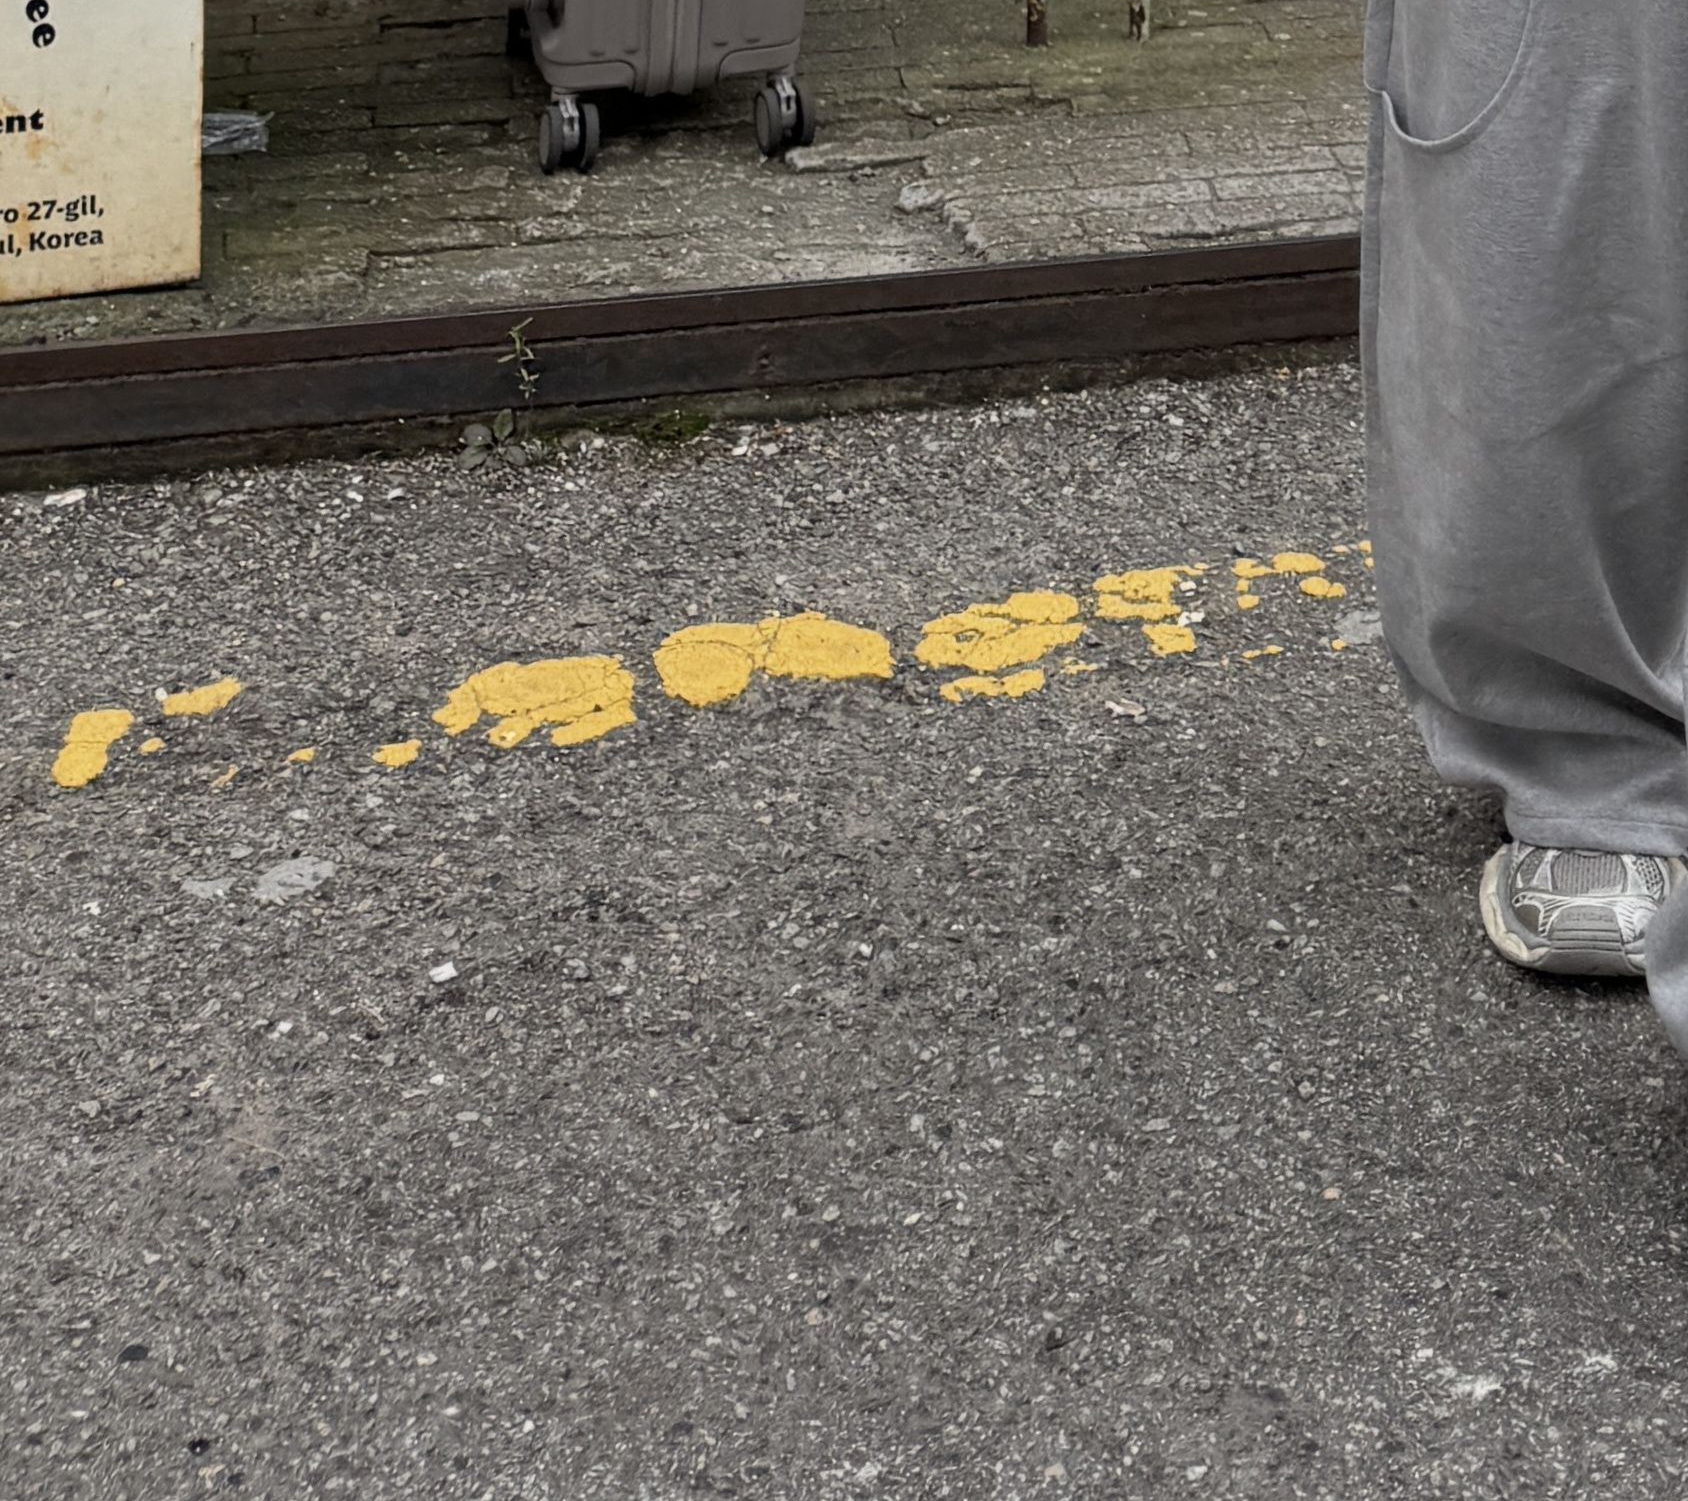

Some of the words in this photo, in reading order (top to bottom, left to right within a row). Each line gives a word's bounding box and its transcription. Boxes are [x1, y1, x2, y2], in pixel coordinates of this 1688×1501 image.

[0, 108, 44, 134] nt
[27, 194, 104, 221] 27-gil,
[29, 229, 104, 251] Korea
